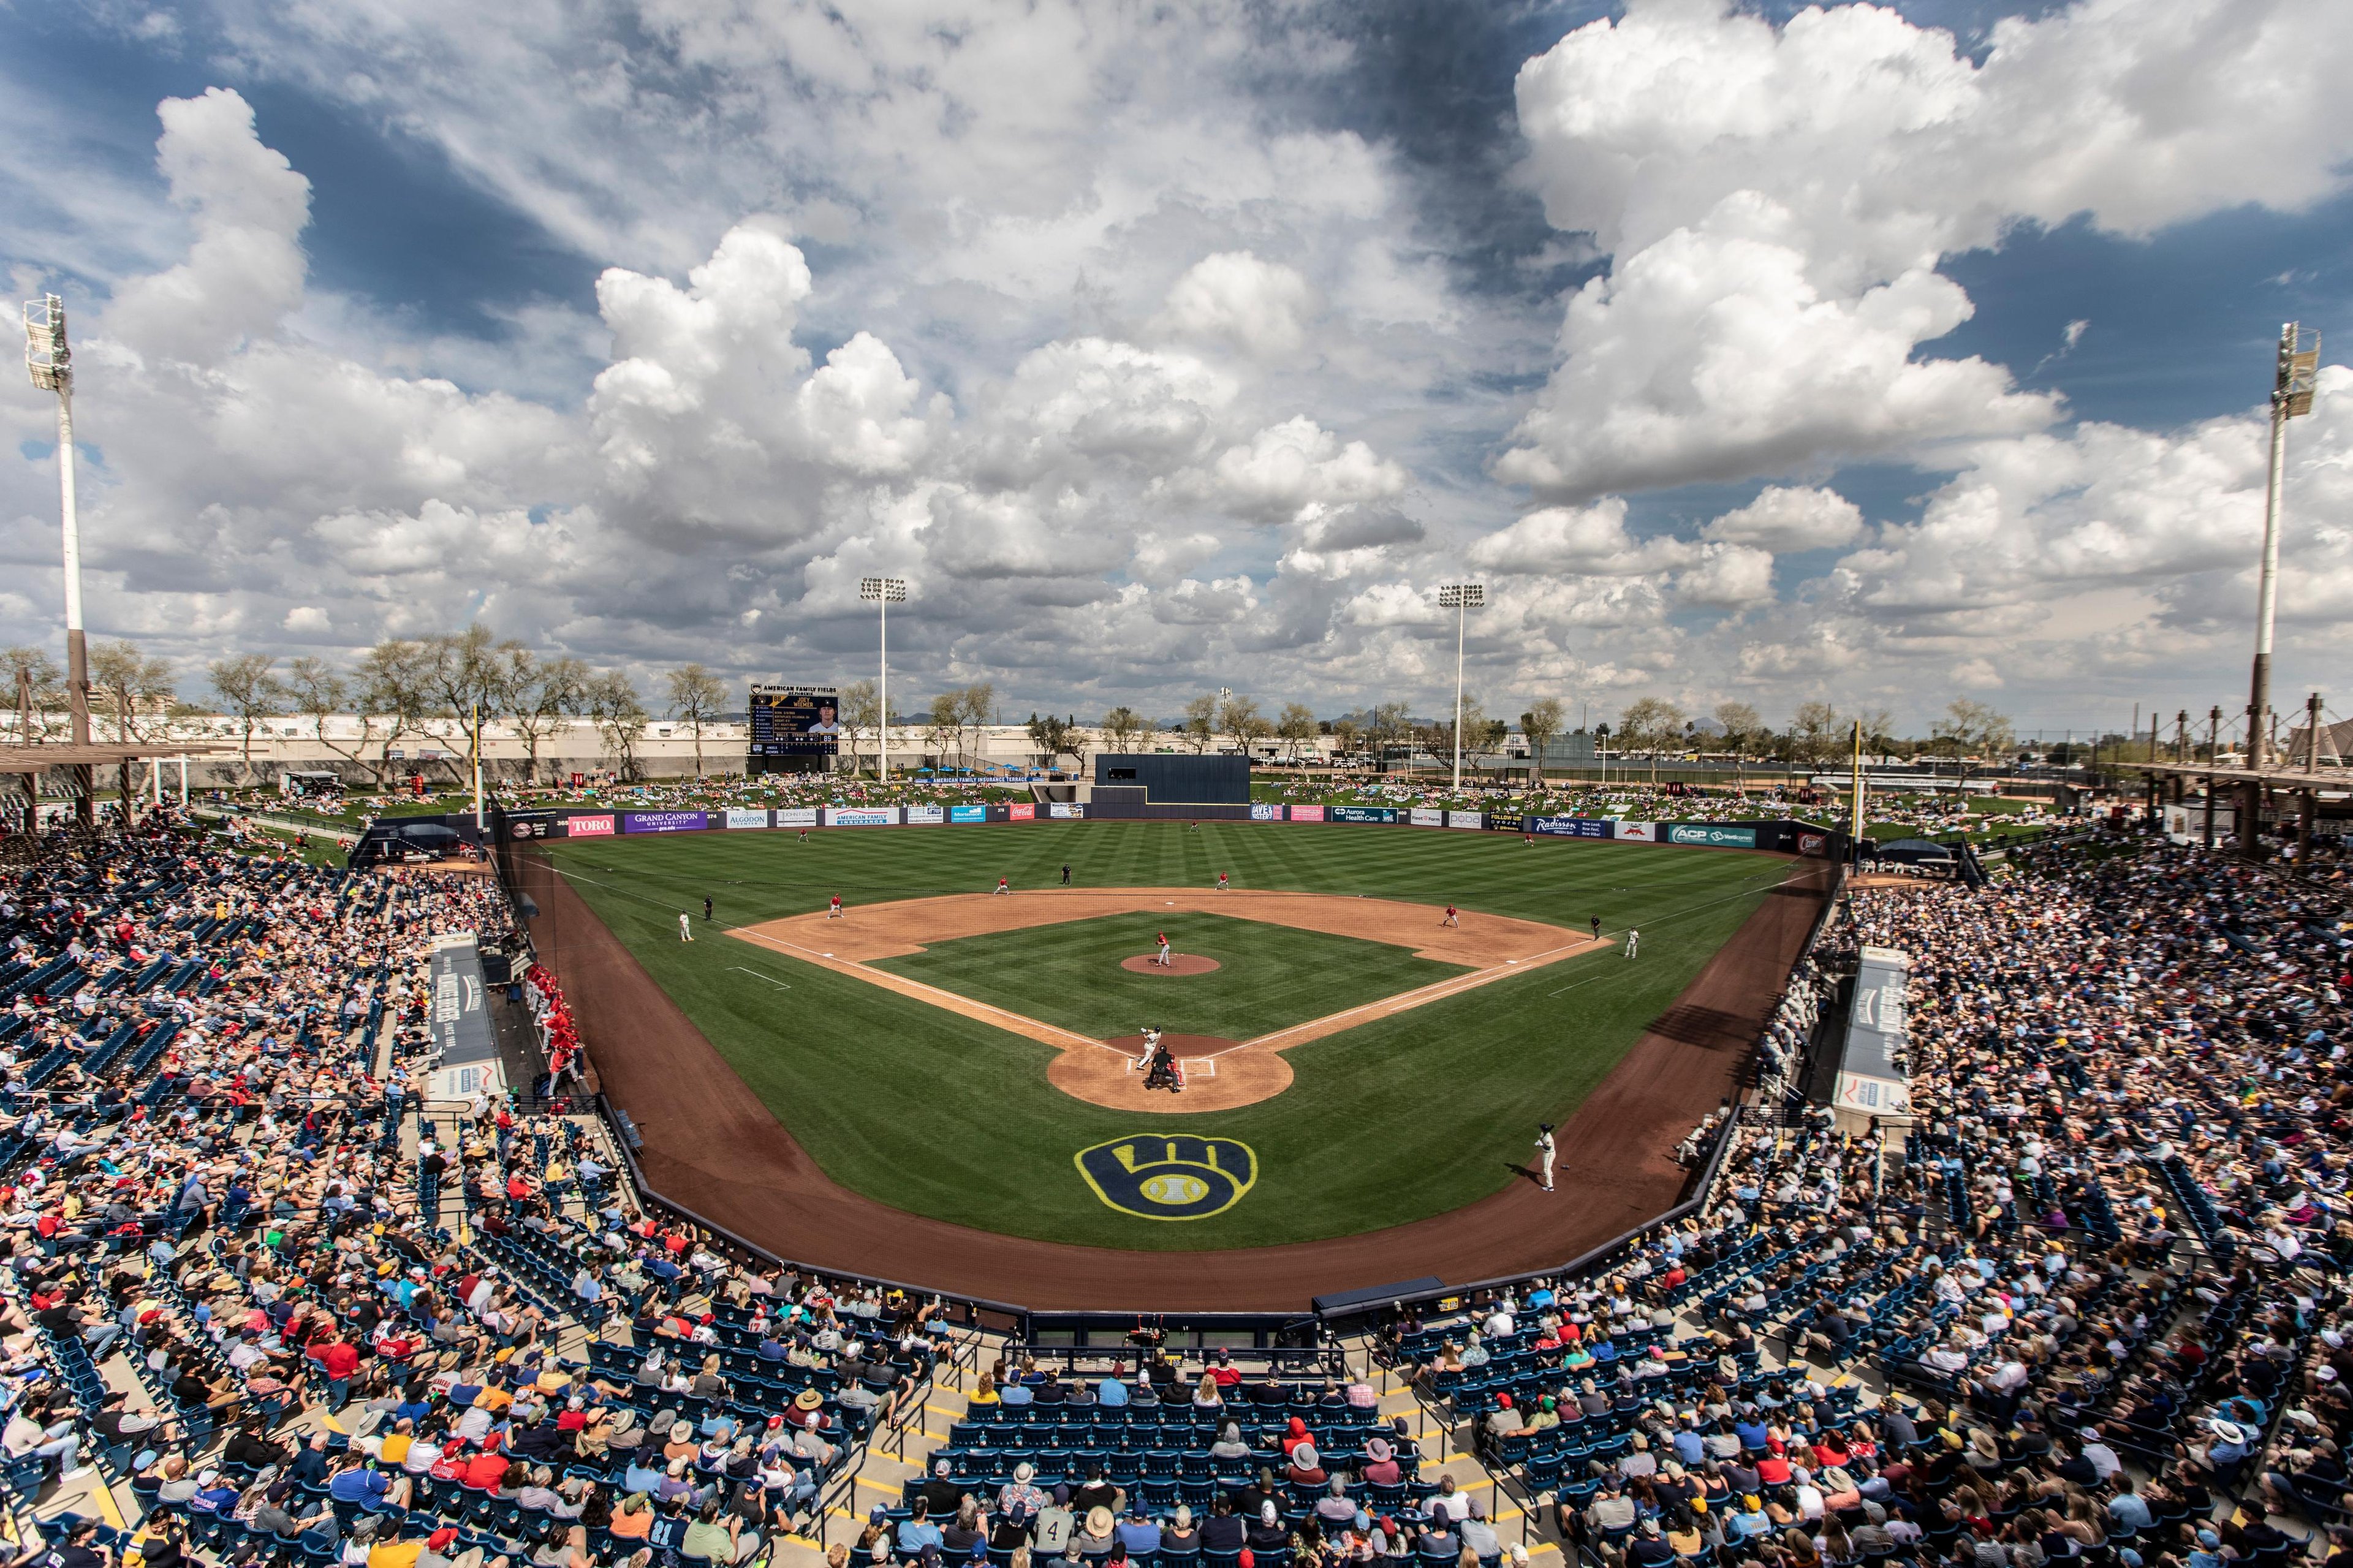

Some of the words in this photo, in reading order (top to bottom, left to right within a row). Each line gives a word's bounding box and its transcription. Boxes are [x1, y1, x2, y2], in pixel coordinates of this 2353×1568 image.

[1012, 806, 1032, 816] Coca-Cola
[1252, 805, 1268, 814] DAVE
[1451, 813, 1480, 825] poba
[1536, 818, 1576, 831] Radisson
[573, 820, 611, 831] TORO
[444, 1022, 454, 1036] SINCE
[750, 1323, 760, 1331] 17
[651, 1520, 672, 1545] 21
[1047, 1521, 1058, 1542] 4
